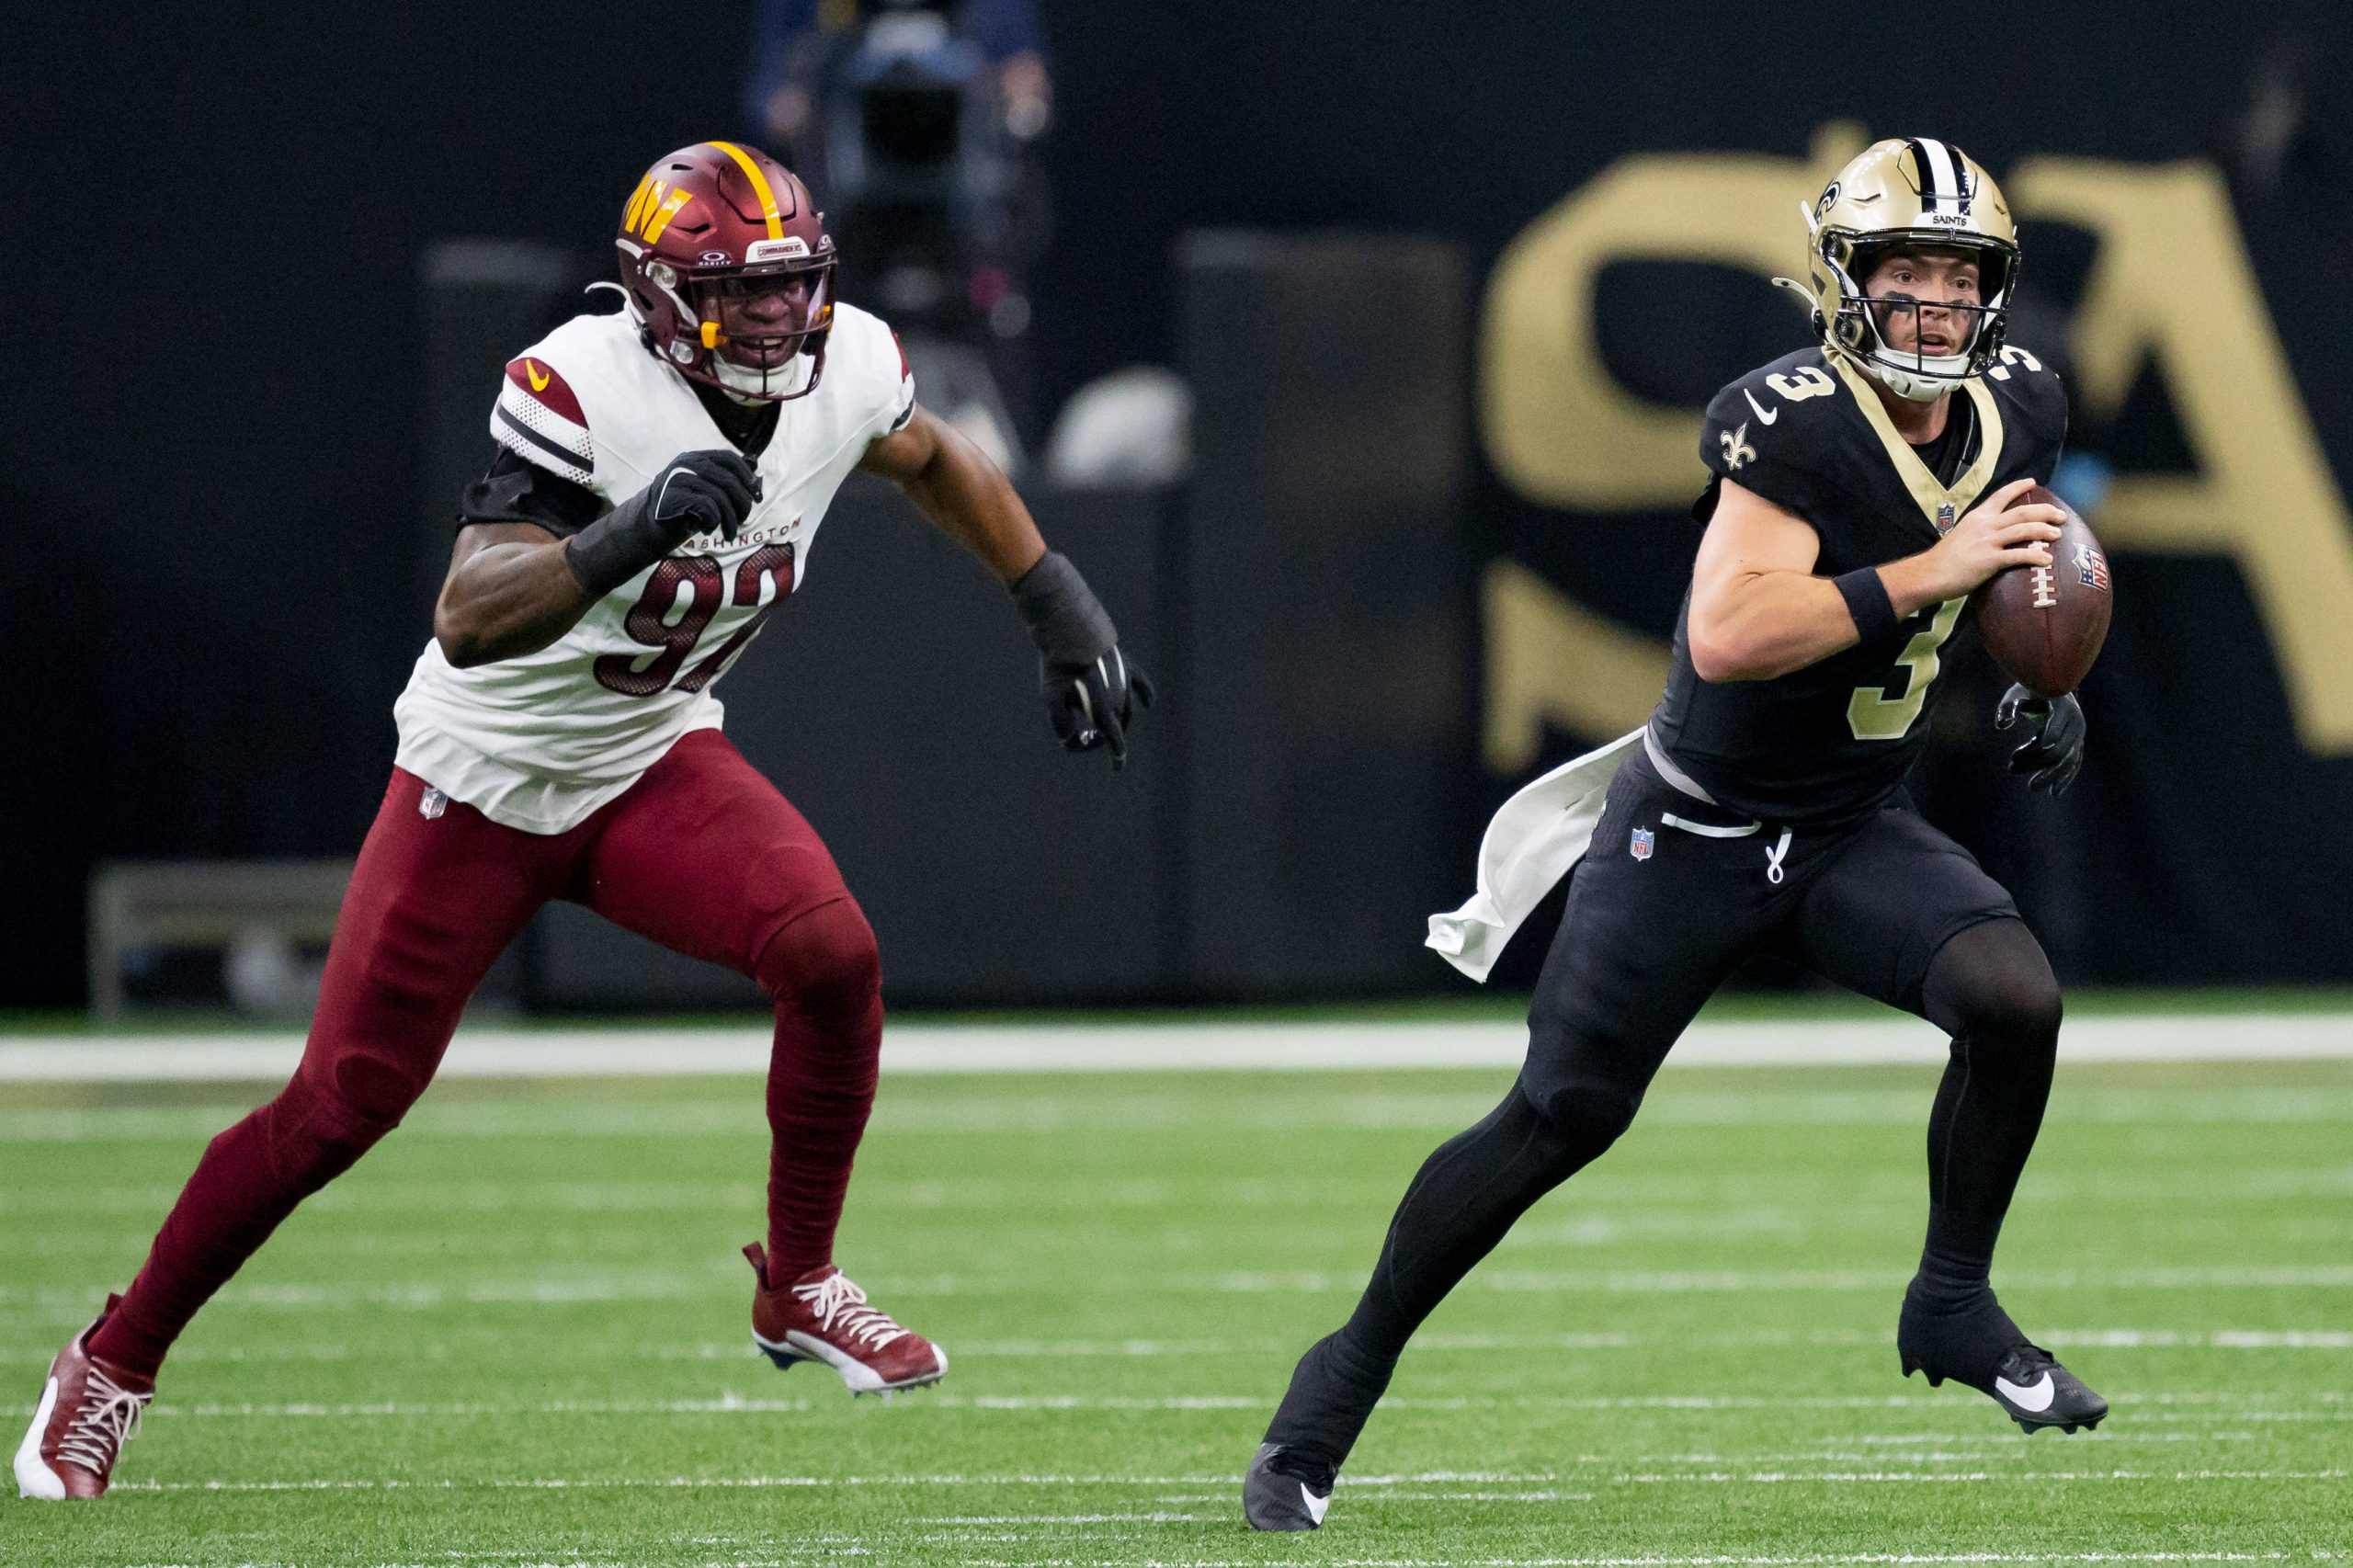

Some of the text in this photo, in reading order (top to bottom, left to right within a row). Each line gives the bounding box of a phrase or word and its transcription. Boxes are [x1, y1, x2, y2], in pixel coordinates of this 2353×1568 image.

[1932, 215, 1967, 227] SAINTS
[757, 243, 802, 257] COMMANDERS
[1766, 366, 1836, 403] 3
[683, 517, 801, 550] ASHINGTON
[2091, 553, 2108, 589] NFL
[593, 542, 795, 699] 92
[1846, 594, 1969, 741] 3
[1633, 841, 1649, 856] NFL
